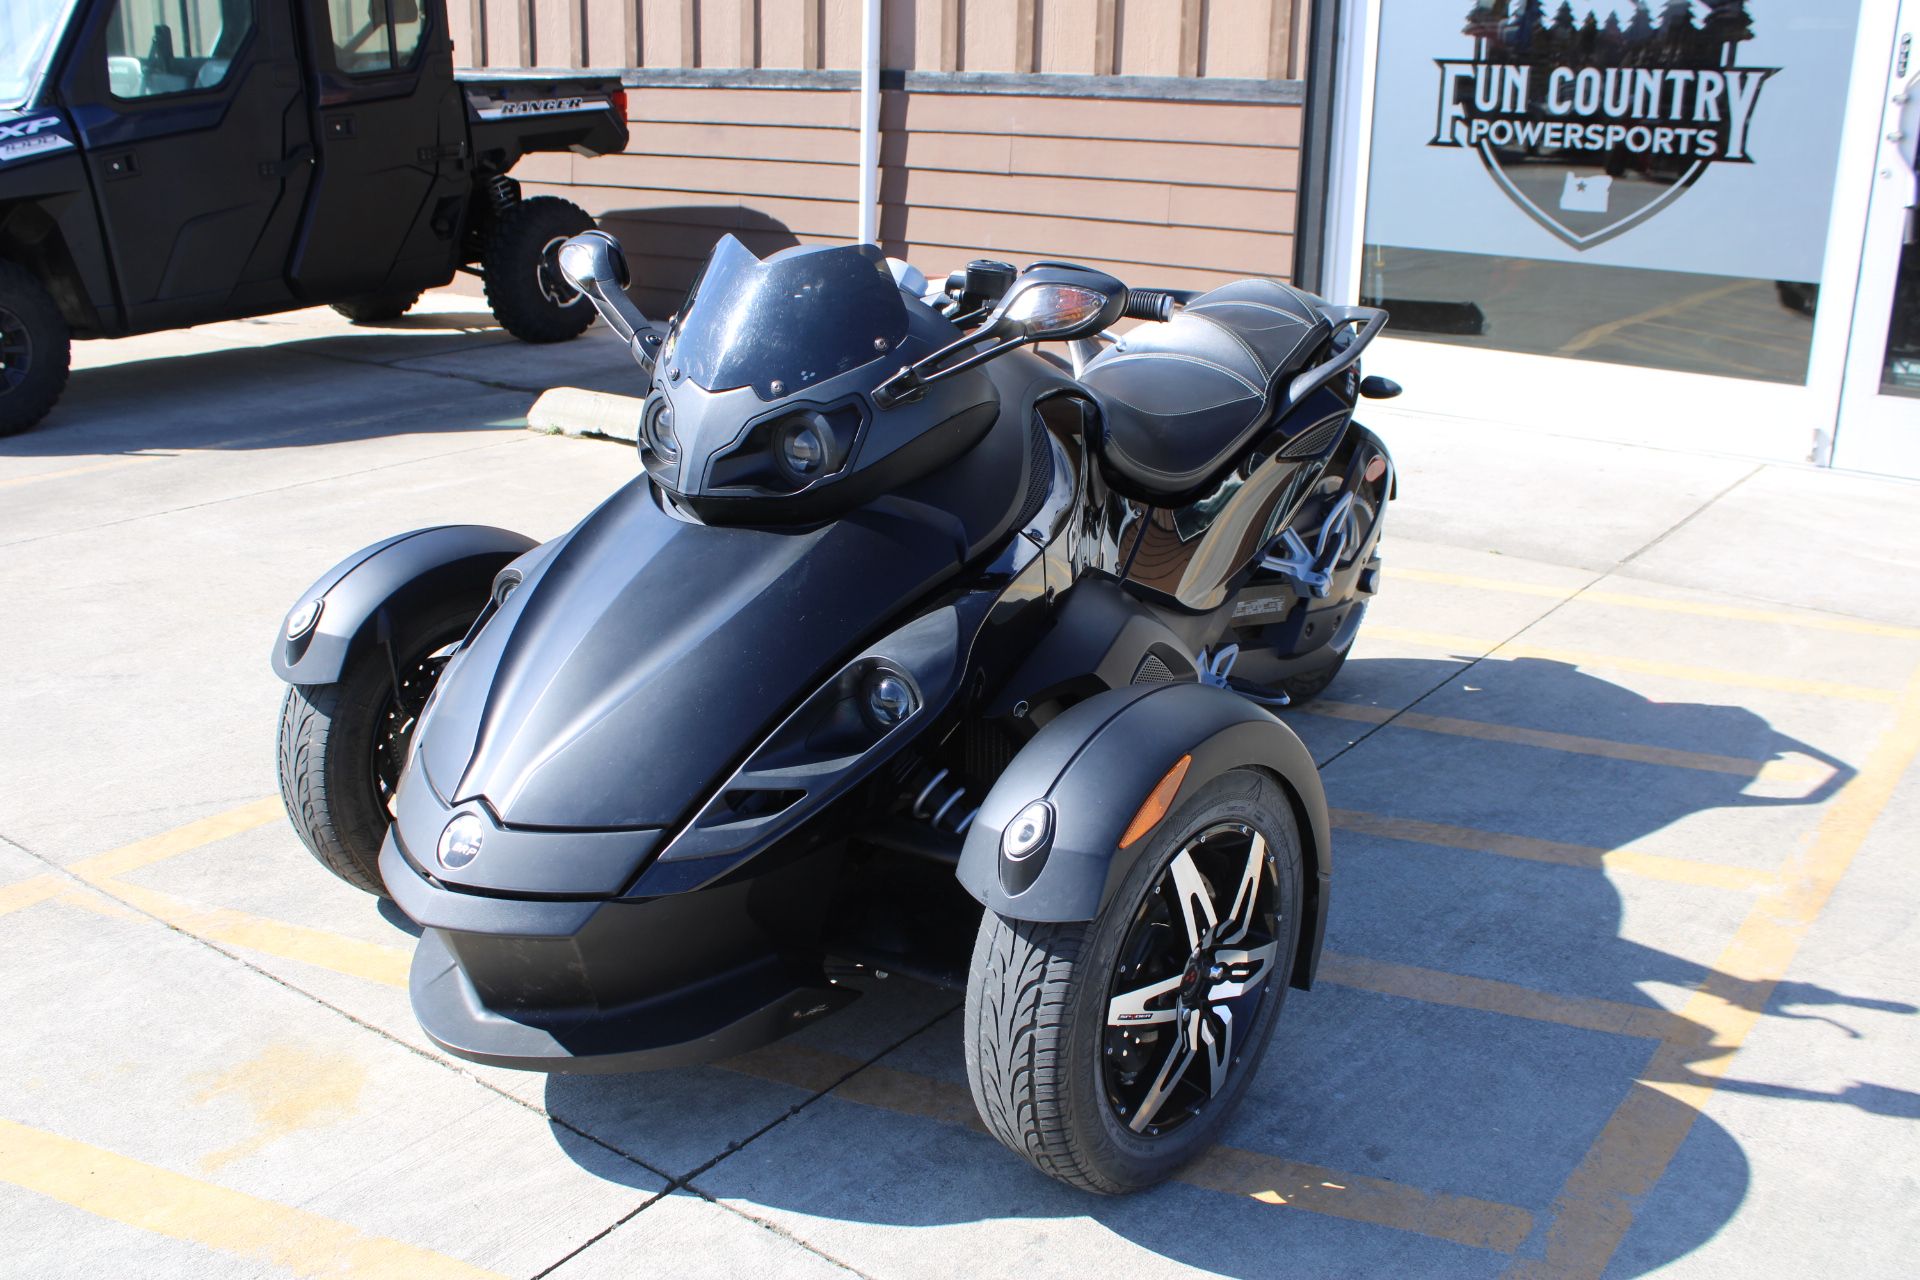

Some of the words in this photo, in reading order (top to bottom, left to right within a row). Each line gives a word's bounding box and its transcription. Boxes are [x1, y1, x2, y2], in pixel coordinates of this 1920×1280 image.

[500, 97, 582, 115] RANGER
[1438, 63, 1530, 147] FUN
[1548, 66, 1765, 158] COUNTRY
[0, 116, 61, 140] XP
[1471, 119, 1718, 157] POWERSPORTS
